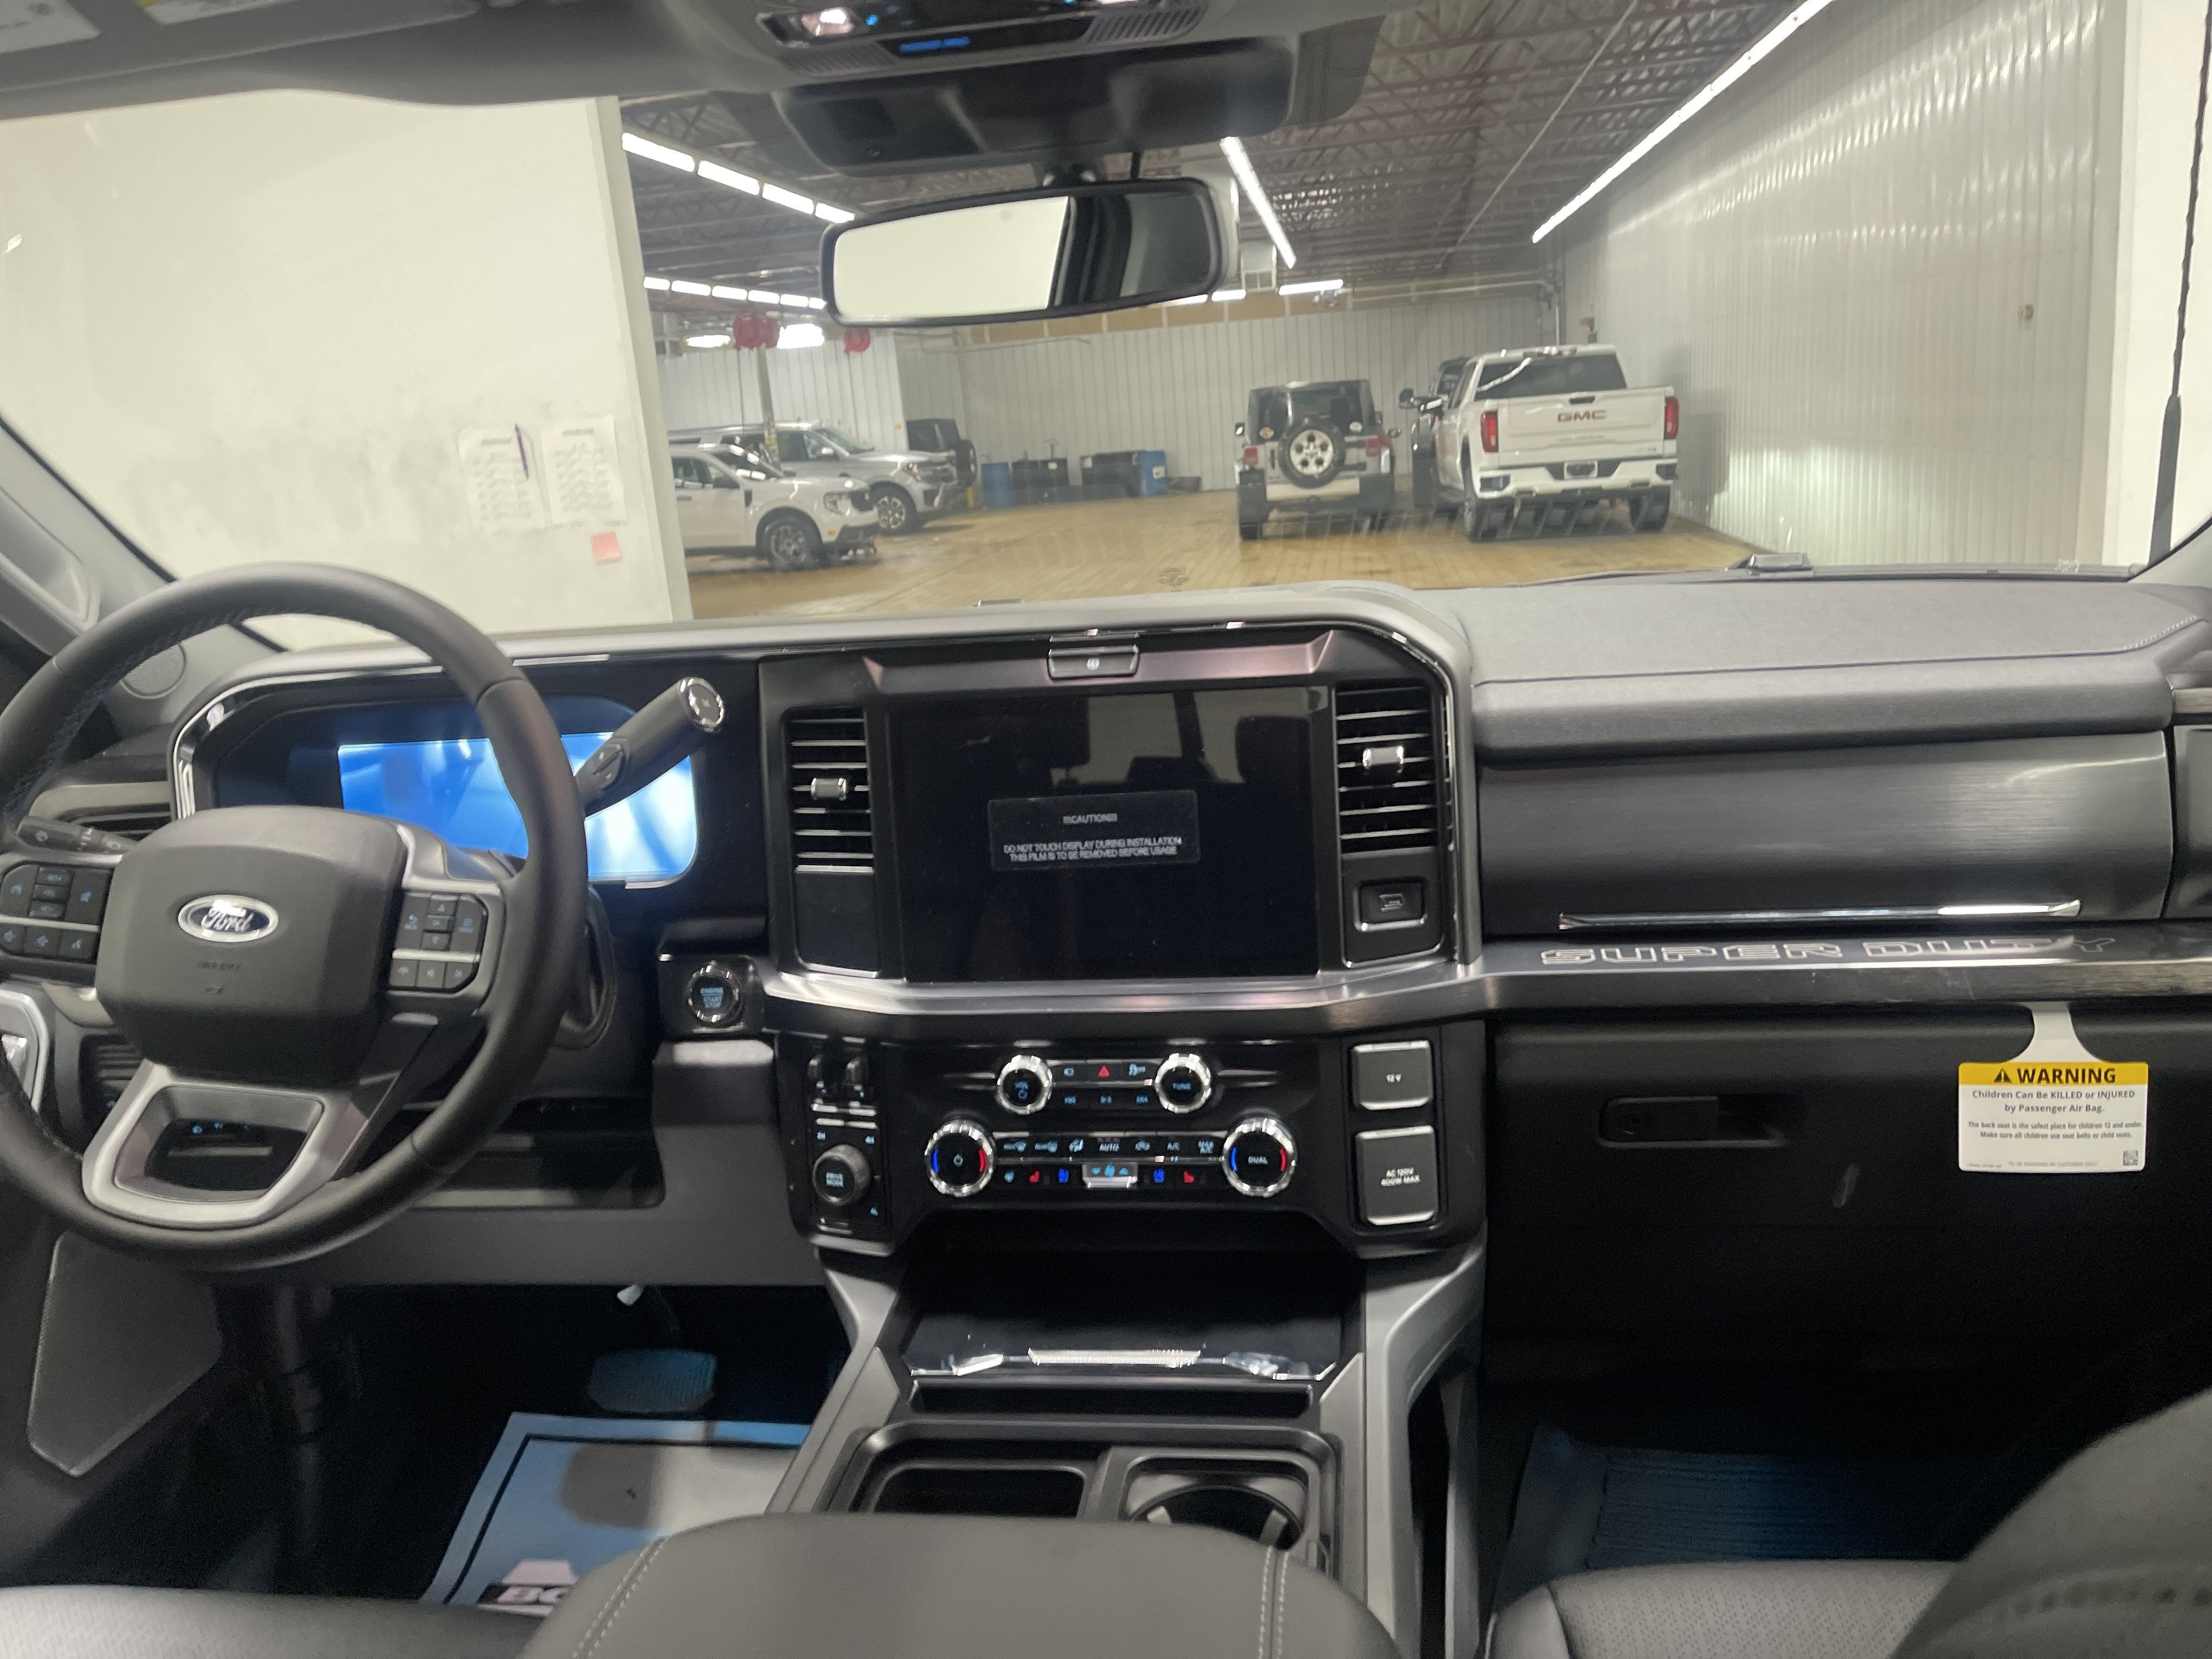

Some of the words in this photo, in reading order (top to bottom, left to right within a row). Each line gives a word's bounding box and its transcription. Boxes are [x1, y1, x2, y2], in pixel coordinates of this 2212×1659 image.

[1558, 409, 1606, 422] GMC
[1003, 844, 1015, 854] DO
[1016, 843, 1033, 853] NOT
[1034, 842, 1062, 852] TOUCH
[1063, 840, 1094, 851] DISPLAY
[1096, 839, 1125, 849] DURING
[1126, 837, 1182, 848] INSTALLATION
[1009, 853, 1028, 862] THIS
[1056, 851, 1067, 860] TO
[1080, 849, 1118, 860] REMOVED
[1119, 848, 1150, 857] BEFORE
[1150, 846, 1177, 856] USAGE
[201, 905, 255, 932] Ford
[1541, 943, 1843, 965] SUPER
[2017, 1068, 2116, 1084] WARNING
[1972, 1090, 2013, 1099] Children
[2016, 1091, 2033, 1099] Can
[2050, 1091, 2083, 1099] KILLED
[2097, 1090, 2135, 1100] INJURED
[2005, 1104, 2016, 1114] by
[2019, 1104, 2067, 1114] Passenger
[2069, 1104, 2083, 1112] Air
[2085, 1104, 2104, 1113] Bag.
[1248, 1155, 1268, 1165] DUAL
